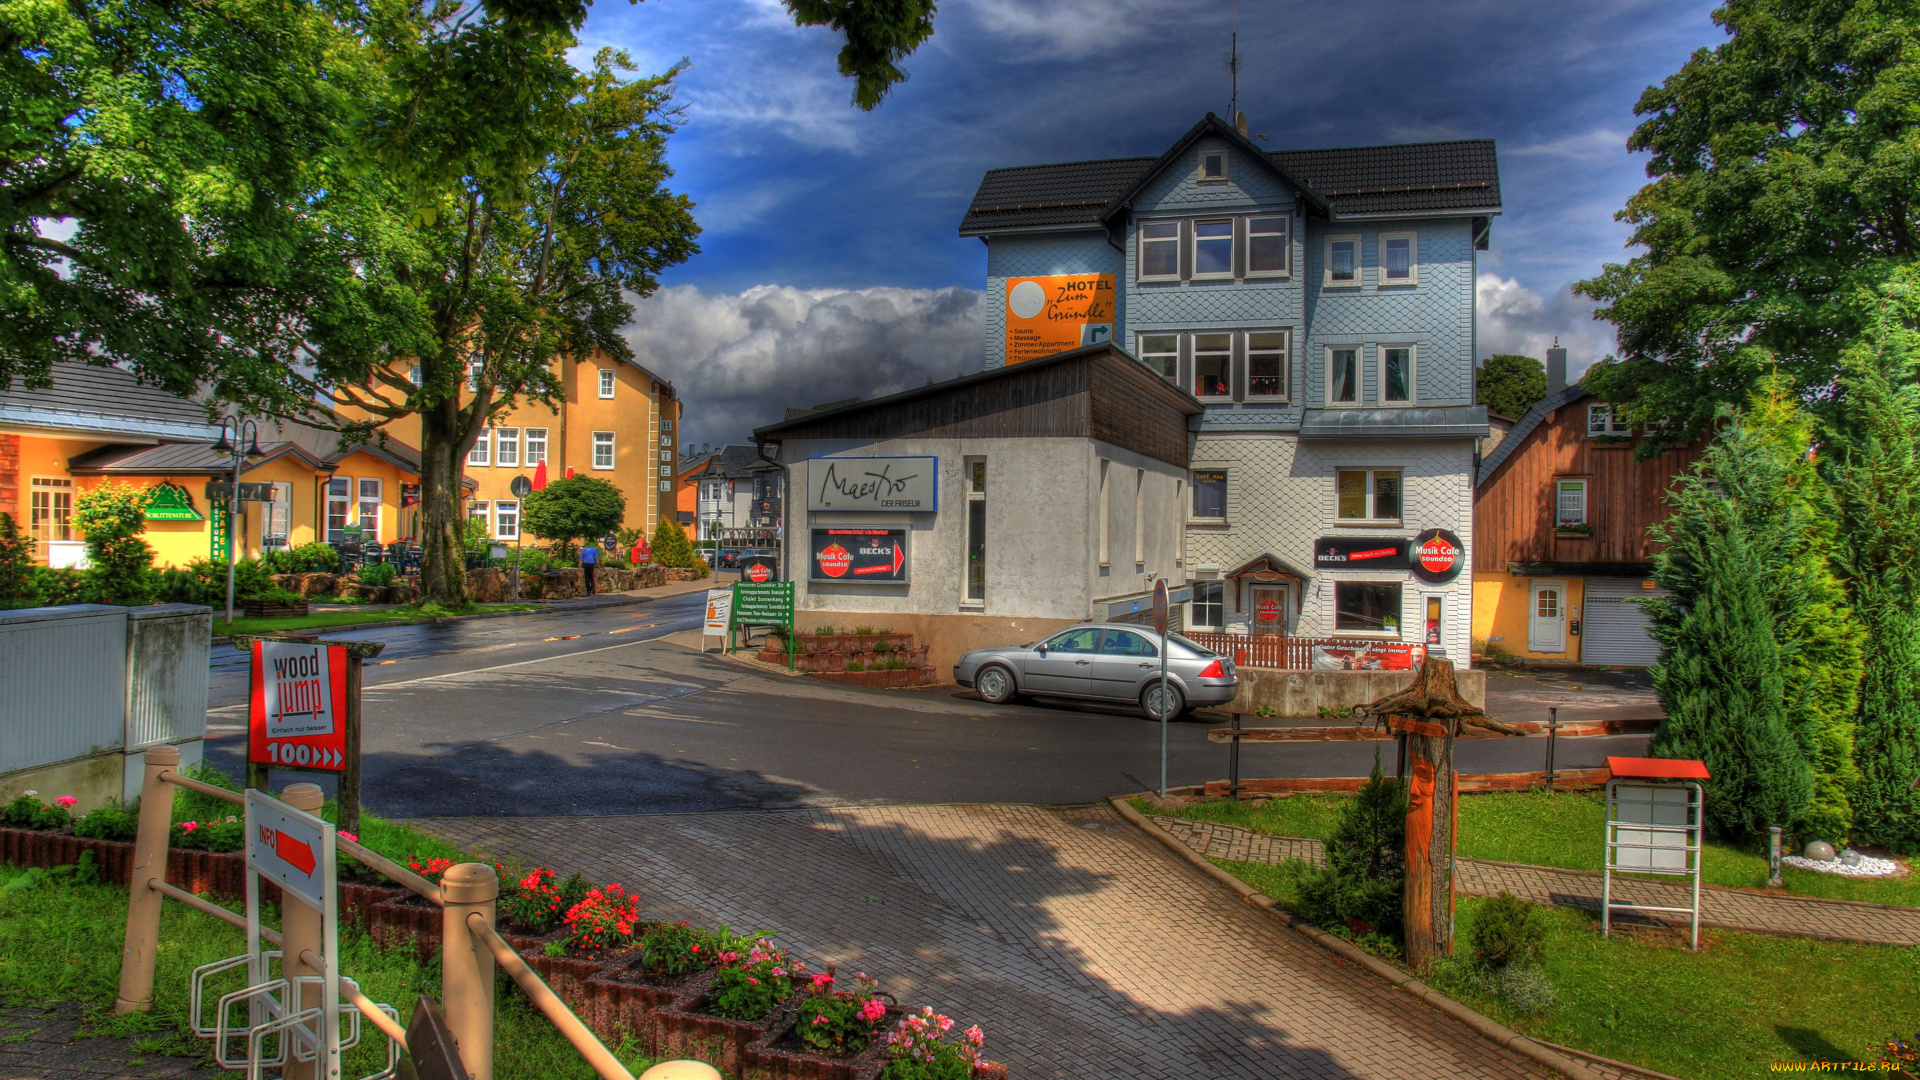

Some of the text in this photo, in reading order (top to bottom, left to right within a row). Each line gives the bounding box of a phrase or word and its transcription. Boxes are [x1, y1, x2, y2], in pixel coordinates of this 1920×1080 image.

[1067, 281, 1112, 291] HOTEL
[661, 421, 671, 491] HOTEL
[820, 462, 919, 504] Maestro
[881, 500, 921, 508] DER FRISEUR
[816, 552, 854, 560] Musik Cafe
[859, 547, 891, 555] BECK'S
[1318, 554, 1347, 562] BECK'S
[1415, 546, 1460, 555] Musik Cafe
[274, 647, 320, 679] wood
[277, 672, 321, 723] jump
[266, 741, 311, 765] 100
[259, 823, 275, 849] INFO
